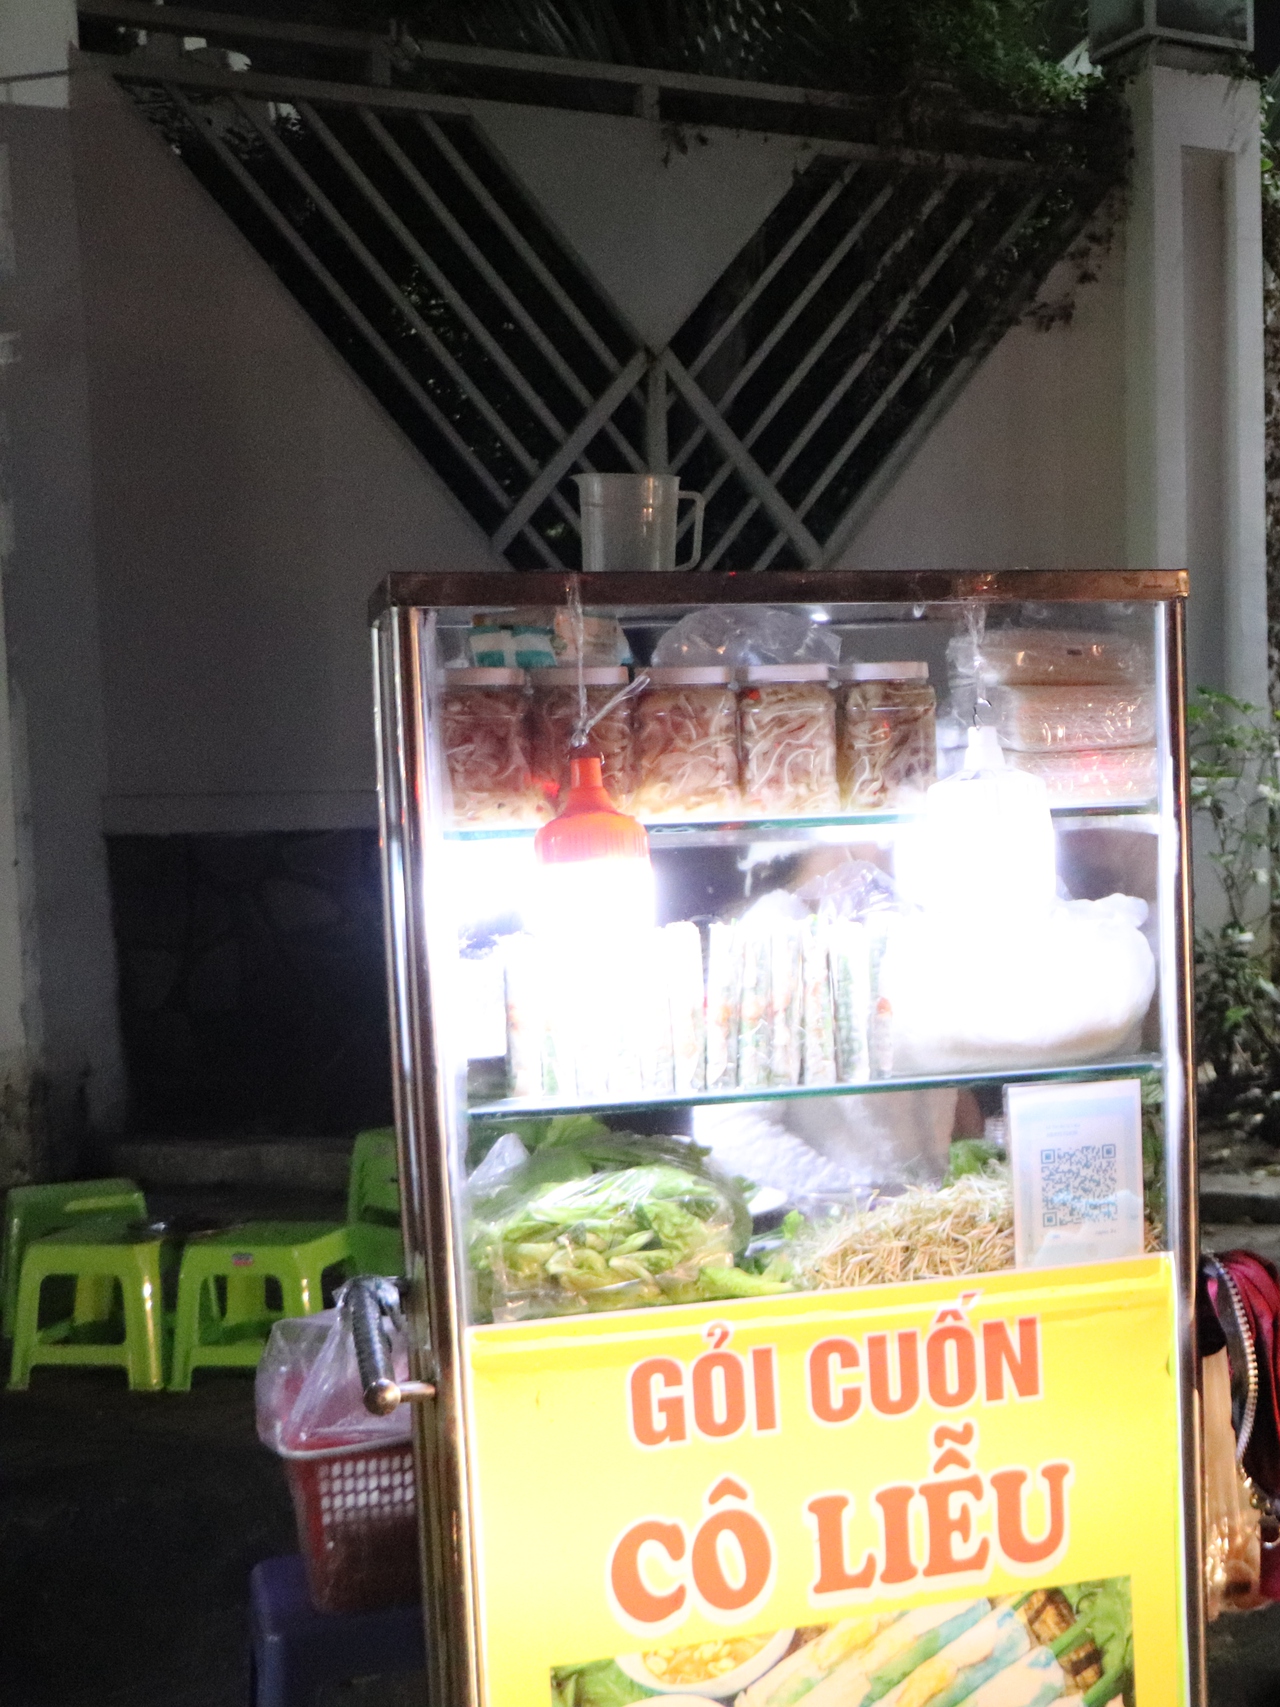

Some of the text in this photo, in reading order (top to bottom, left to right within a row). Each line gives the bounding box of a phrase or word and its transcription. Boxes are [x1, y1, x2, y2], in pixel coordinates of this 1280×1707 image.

[630, 1292, 1041, 1446] GỎI CUỐN
[611, 1423, 1070, 1623] CÔ LIỄU
